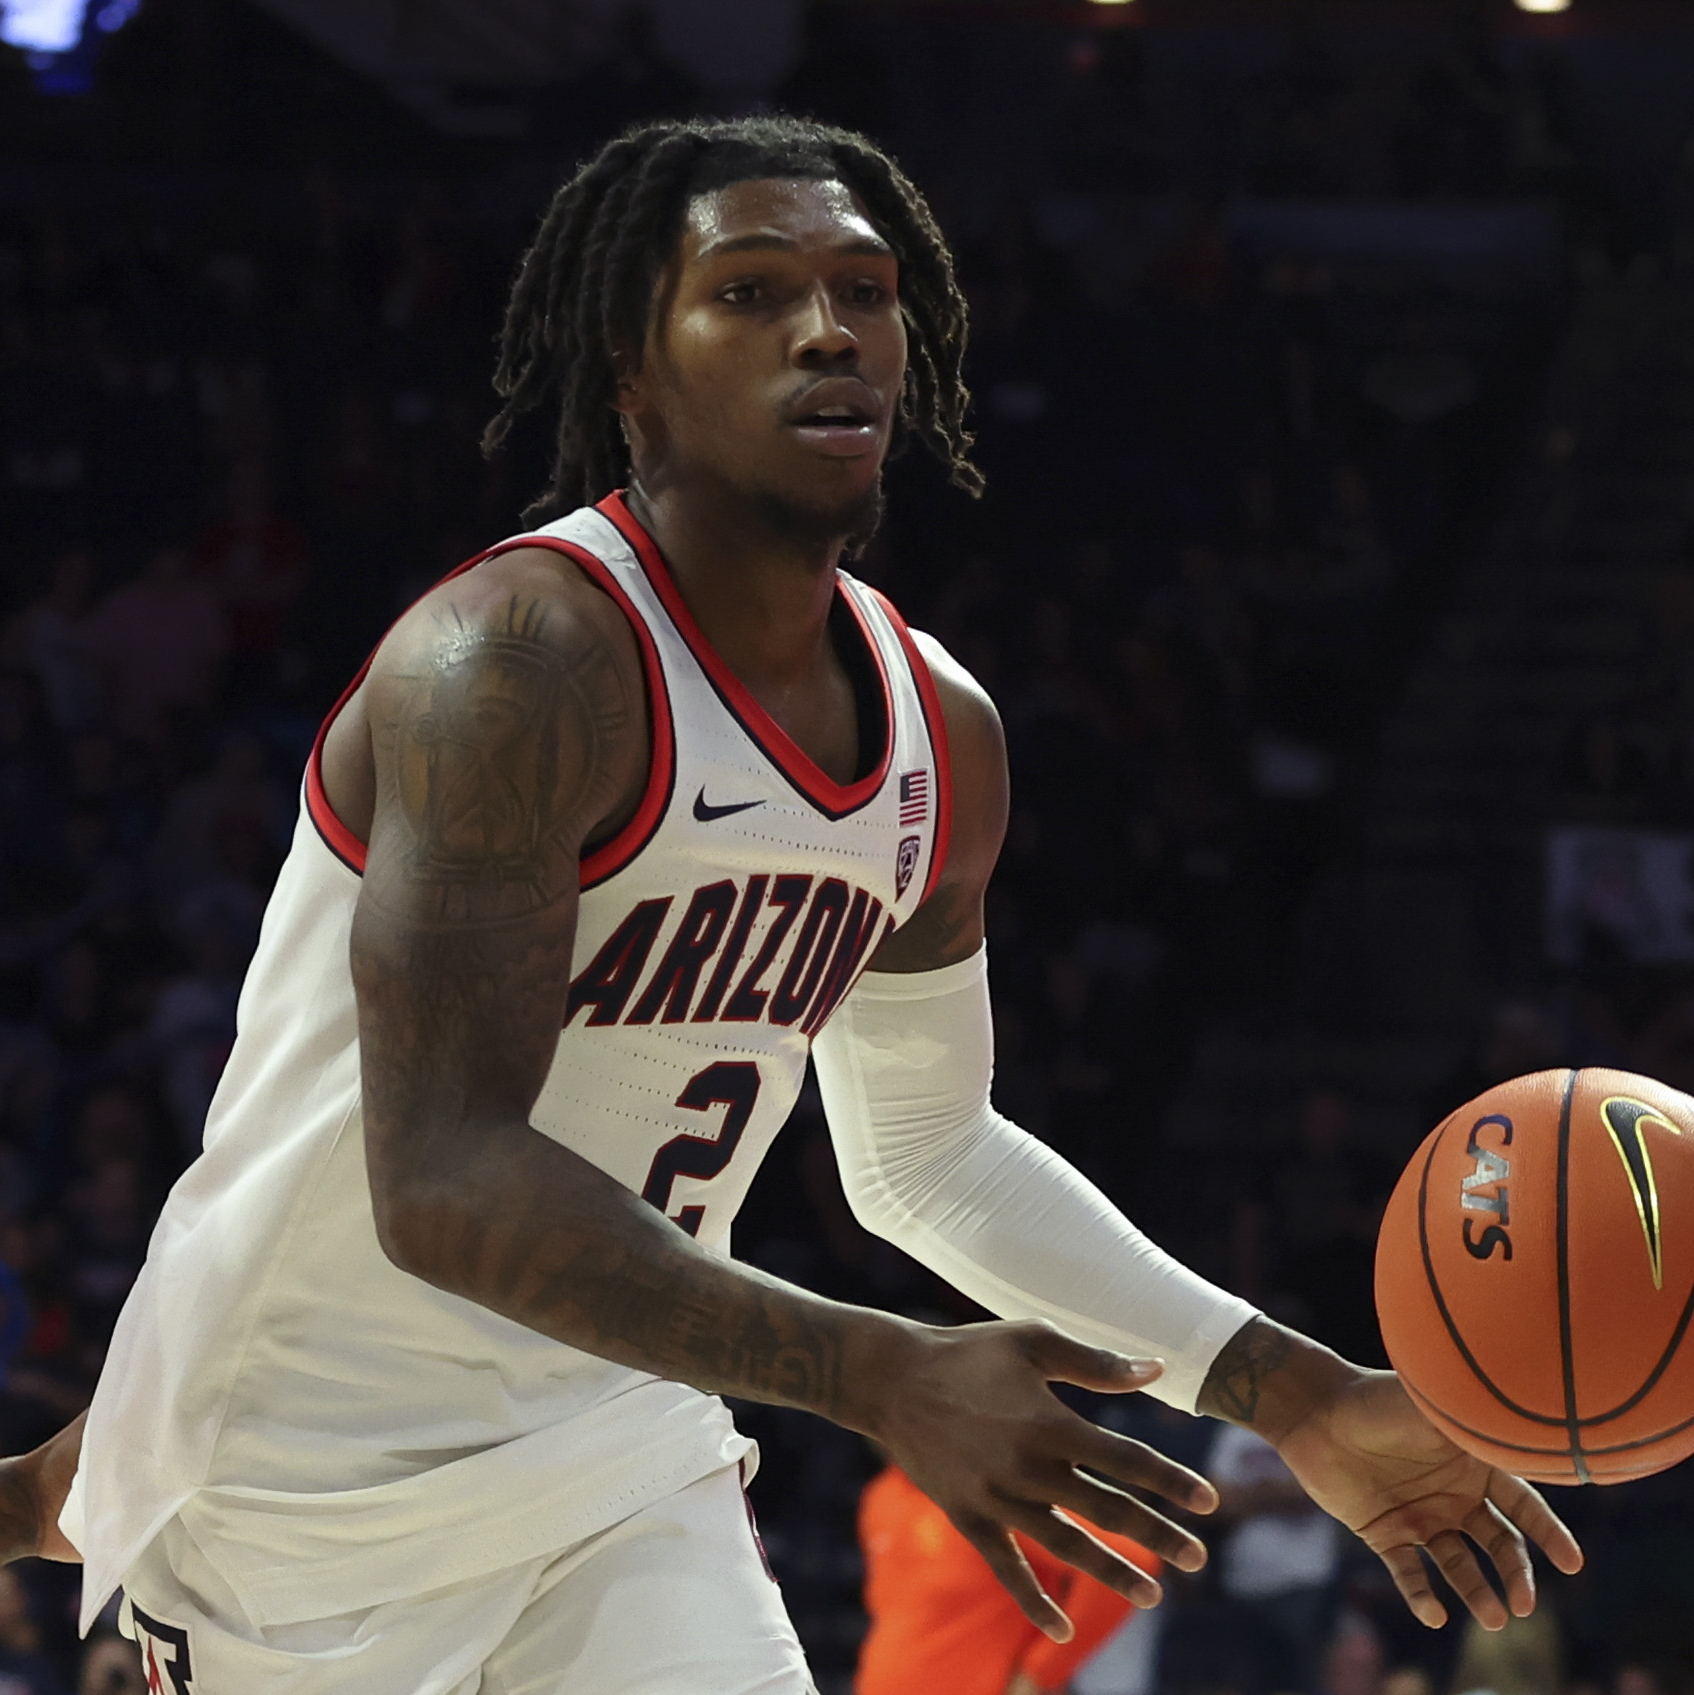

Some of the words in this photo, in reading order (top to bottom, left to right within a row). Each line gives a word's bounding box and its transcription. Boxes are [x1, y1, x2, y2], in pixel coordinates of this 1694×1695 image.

[562, 873, 897, 1037] ARIZON
[641, 1060, 761, 1238] 2
[1461, 1113, 1513, 1261] CATS
